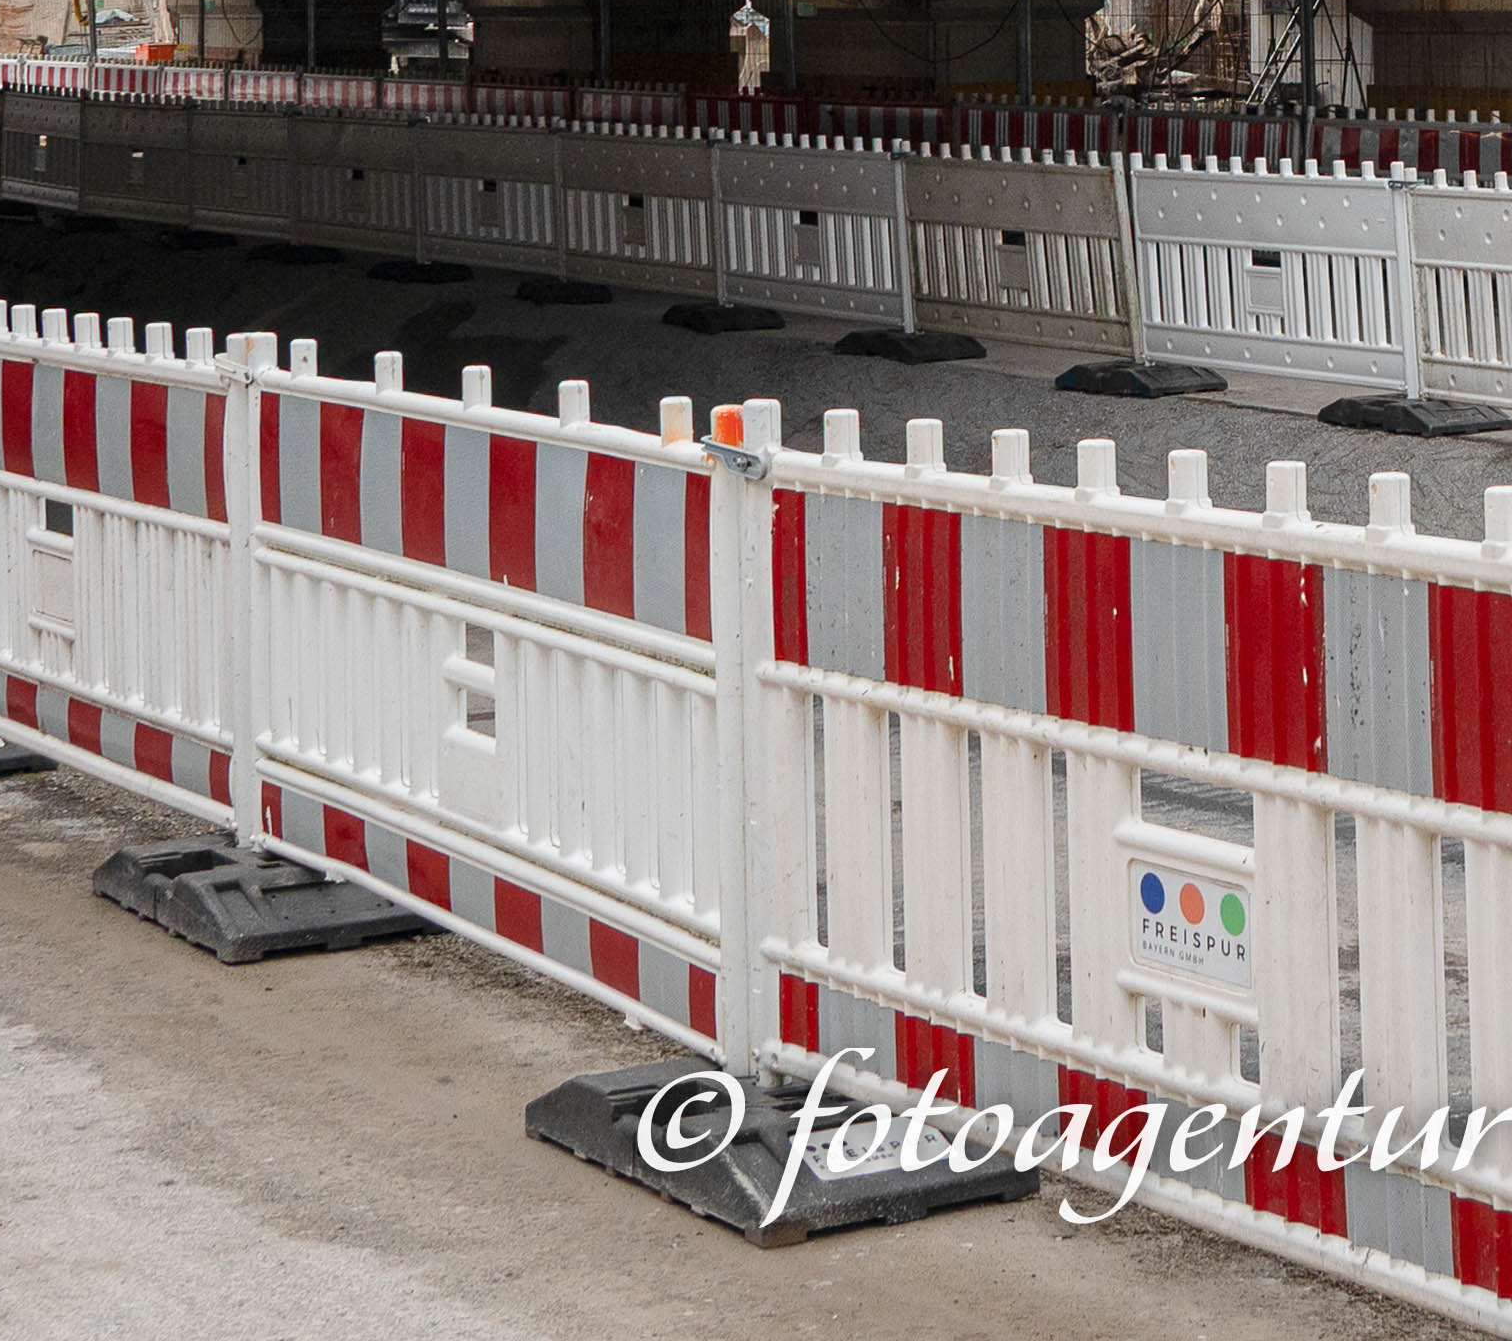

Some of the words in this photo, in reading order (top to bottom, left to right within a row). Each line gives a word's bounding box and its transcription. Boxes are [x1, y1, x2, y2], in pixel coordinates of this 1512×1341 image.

[1142, 918, 1246, 962] FREISPUR
[1142, 940, 1175, 958] BAYERN
[1178, 950, 1205, 965] GMBH
